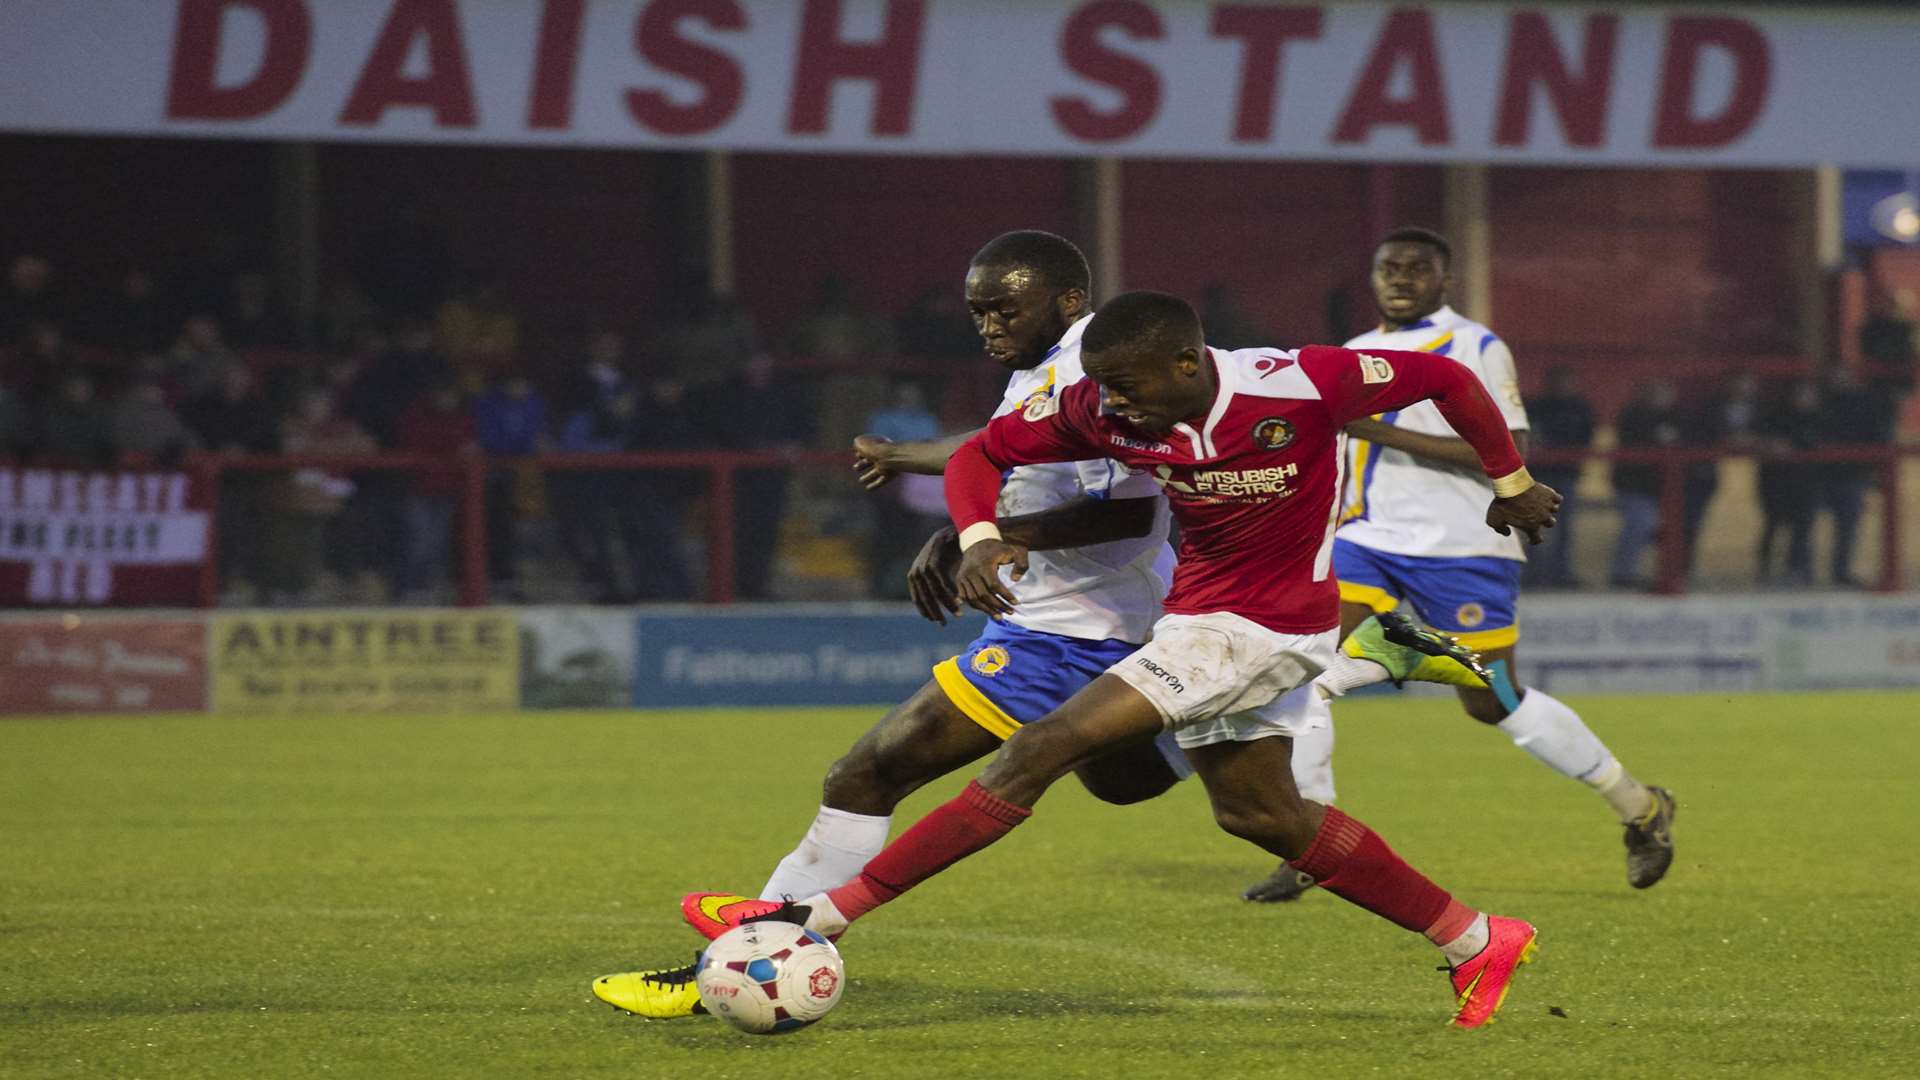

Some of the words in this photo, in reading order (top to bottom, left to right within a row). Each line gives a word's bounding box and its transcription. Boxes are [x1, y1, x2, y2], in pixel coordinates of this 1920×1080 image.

[164, 0, 925, 138] DAISH
[1050, 0, 1775, 151] STAND
[1193, 463, 1298, 484] MITSUBISHI
[1196, 480, 1287, 496] ELECTRIC
[227, 613, 508, 652] AINTREE
[1136, 657, 1185, 695] macron
